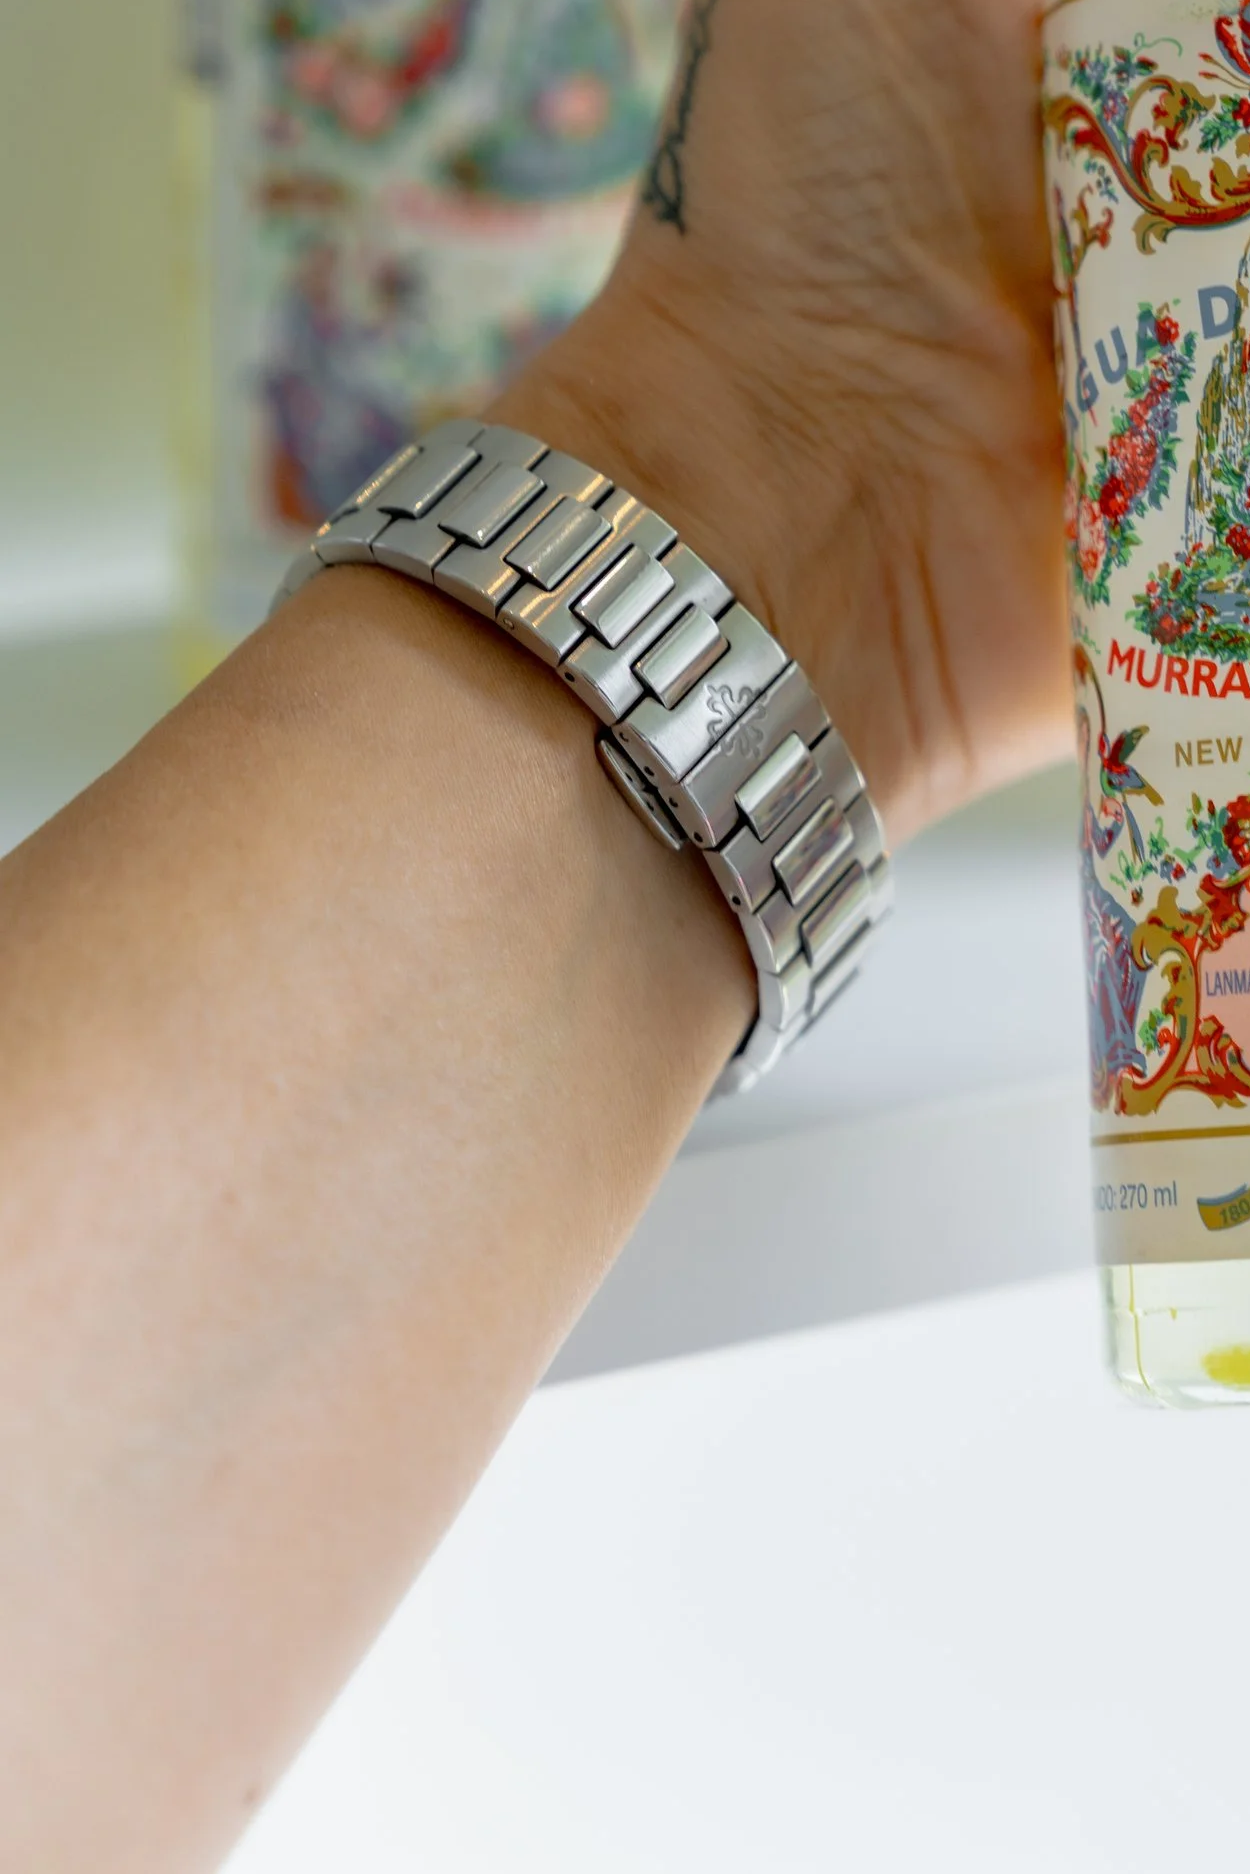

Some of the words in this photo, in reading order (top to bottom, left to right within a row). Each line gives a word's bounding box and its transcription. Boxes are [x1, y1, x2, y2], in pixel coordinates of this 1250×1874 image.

[1175, 736, 1243, 767] NEW
[1120, 1182, 1148, 1210] 270
[1153, 1179, 1178, 1208] ml
